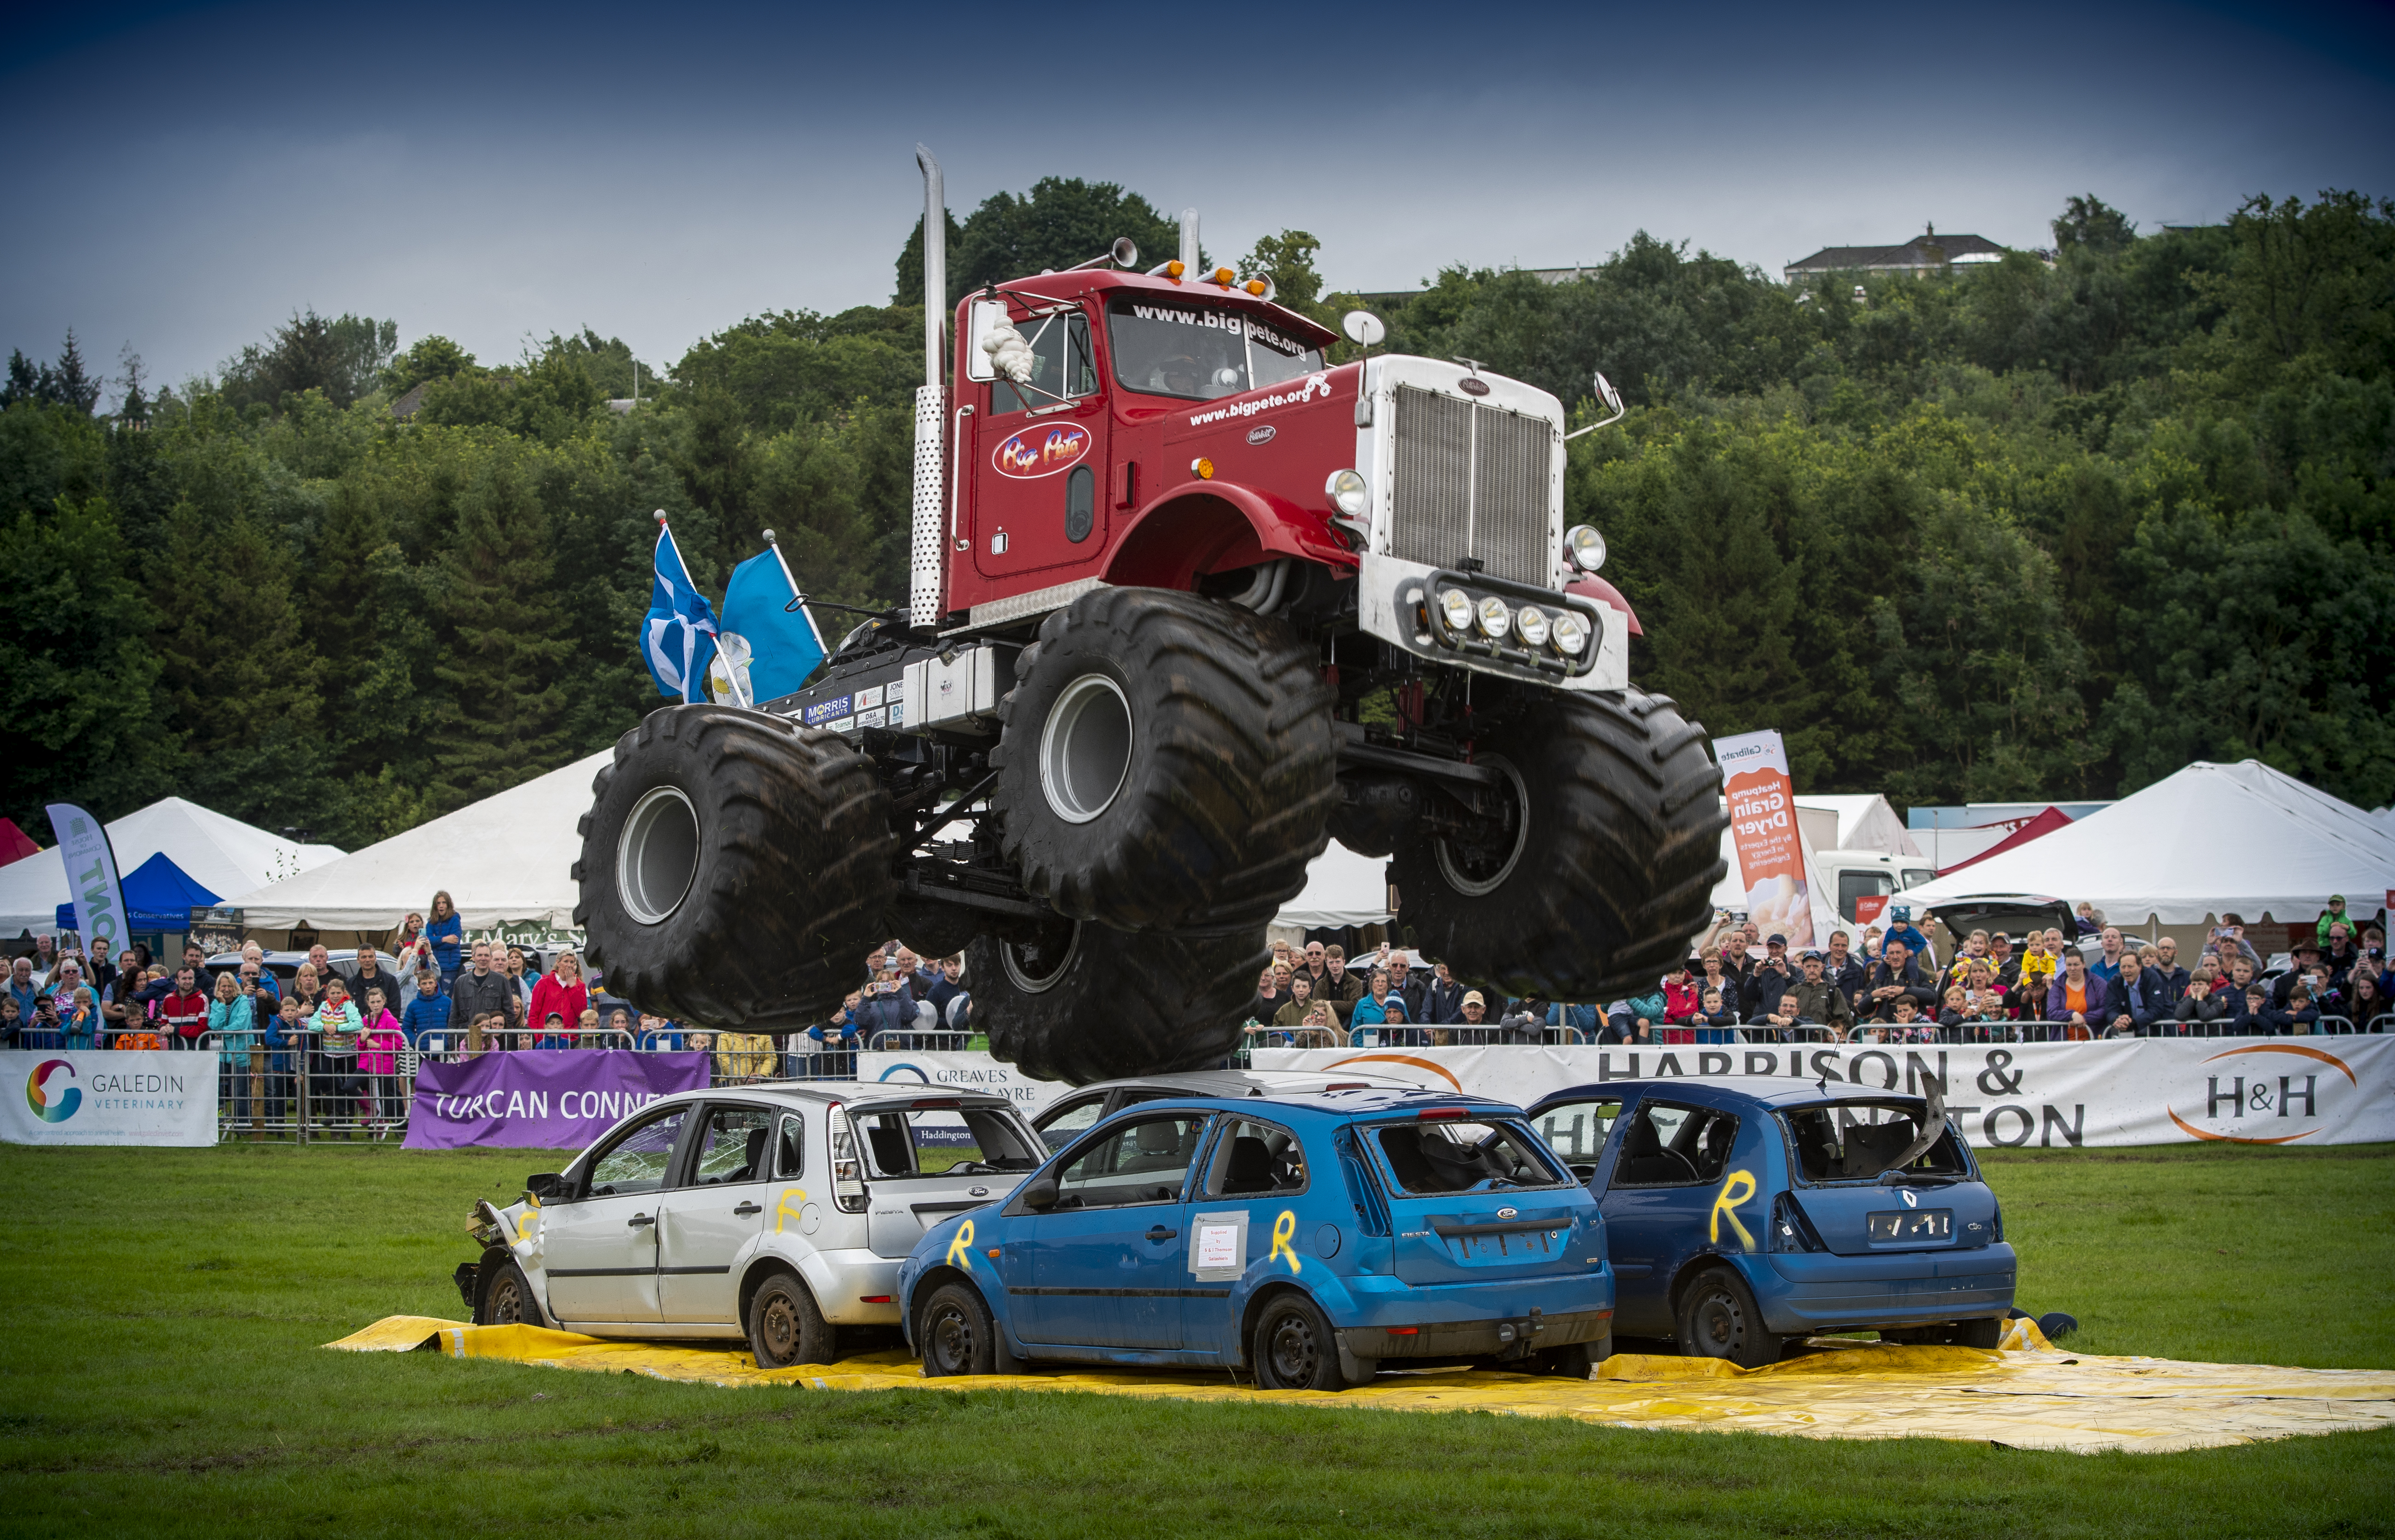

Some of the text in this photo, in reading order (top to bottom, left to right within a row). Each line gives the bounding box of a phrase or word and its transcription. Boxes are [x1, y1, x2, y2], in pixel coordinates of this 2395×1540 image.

[1190, 389, 1311, 426] www.bigpete.org
[1003, 430, 1083, 475] Big Pete
[890, 682, 903, 691] JONE
[808, 697, 848, 718] MORRIS
[808, 708, 848, 724] LUBRICANTS
[835, 721, 852, 729] Teamac
[857, 717, 878, 726] HYDRAULICS
[133, 911, 184, 920] Conservatives
[936, 1070, 1007, 1083] GREAVES
[1977, 1049, 2023, 1096] &
[92, 1075, 183, 1093] GALEDIN
[997, 1087, 1035, 1101] AYRE
[2207, 1075, 2317, 1118] H&H
[95, 1099, 184, 1109] VETERINARY
[436, 1090, 548, 1119] TURCAN
[921, 1130, 971, 1141] Haddington
[1710, 1169, 1756, 1255] R
[1968, 1222, 1982, 1231] Clio
[947, 1219, 974, 1272] R
[1269, 1210, 1301, 1274] R
